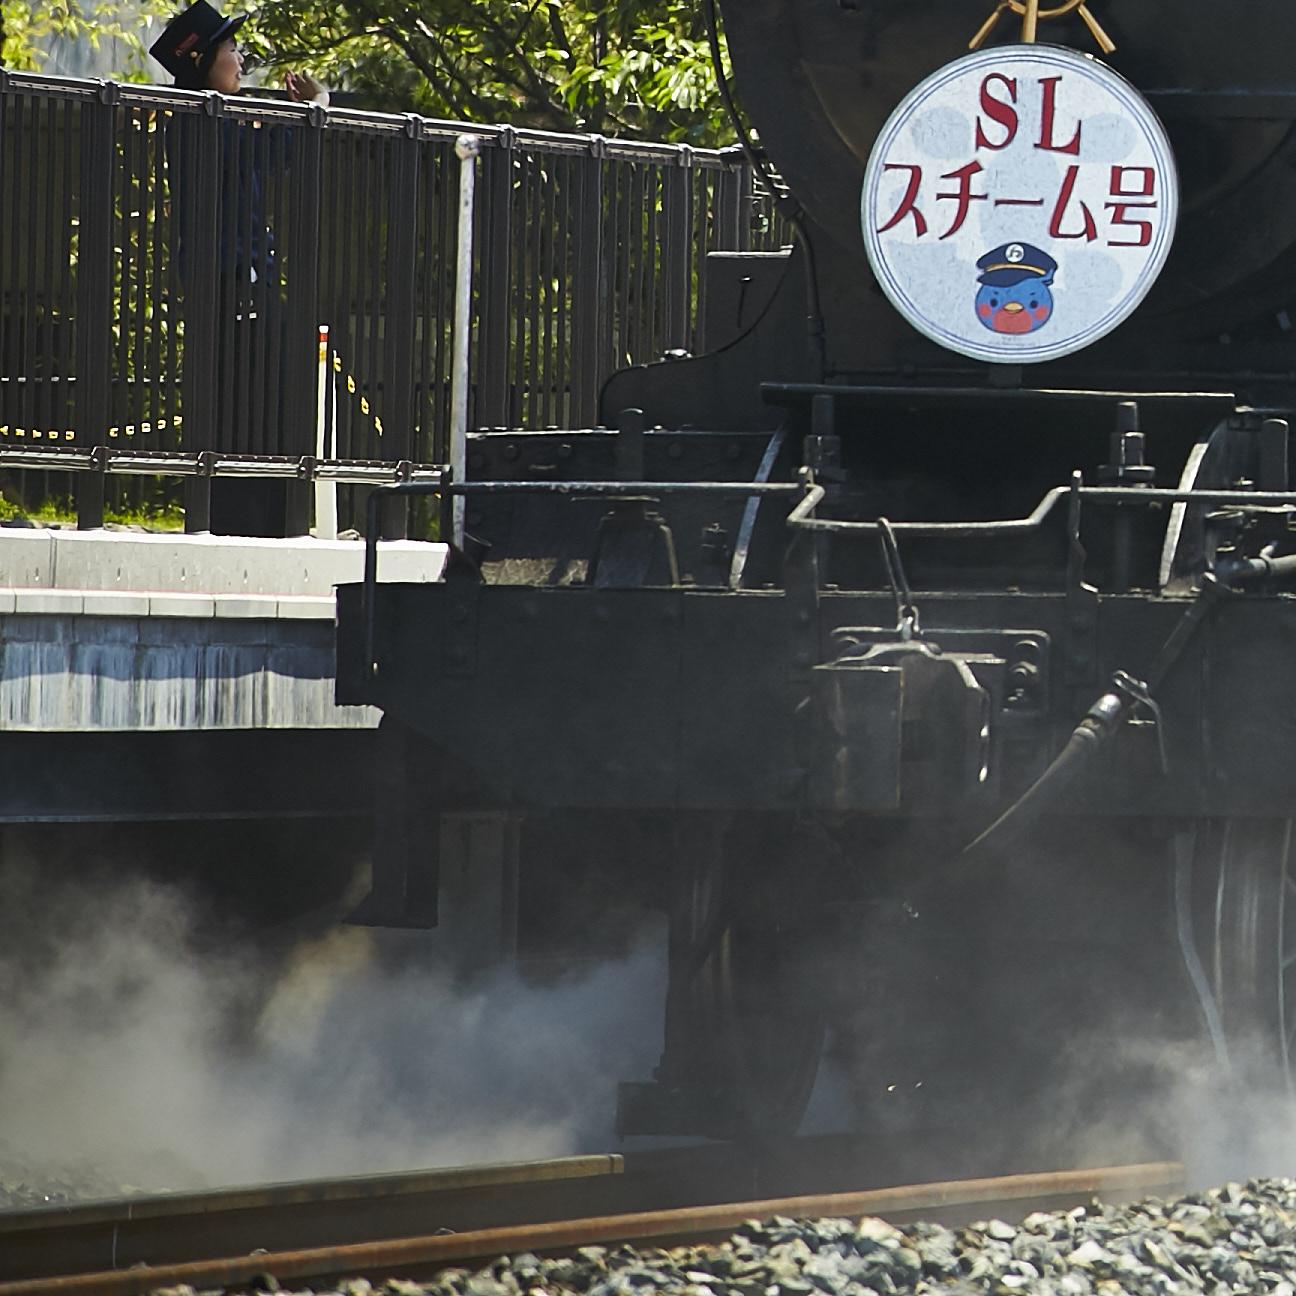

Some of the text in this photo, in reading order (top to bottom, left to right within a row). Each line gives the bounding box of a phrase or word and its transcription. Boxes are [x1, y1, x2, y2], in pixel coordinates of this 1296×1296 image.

[974, 72, 1081, 157] SL
[876, 159, 1158, 248] スチーム号
